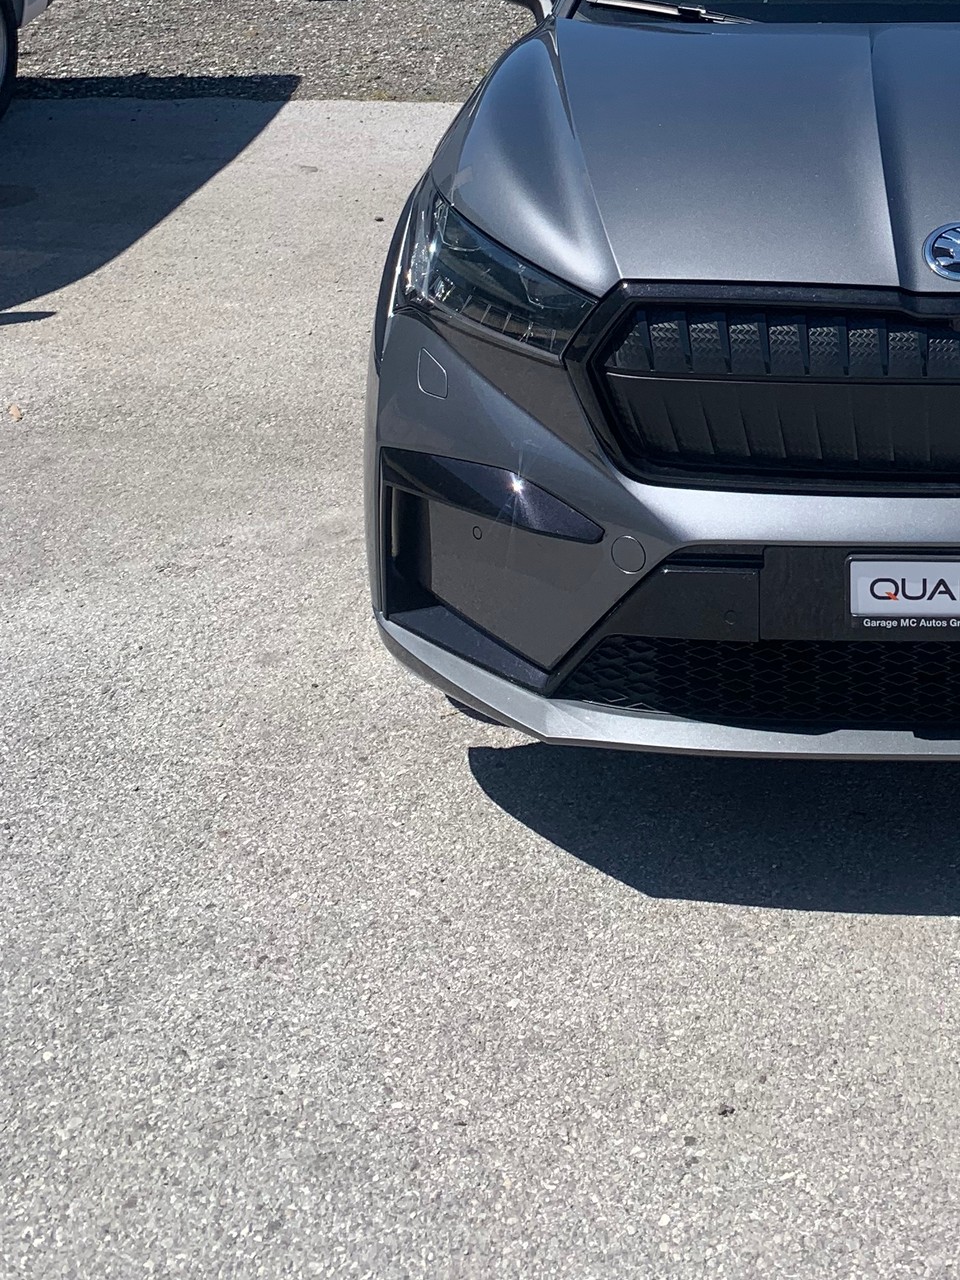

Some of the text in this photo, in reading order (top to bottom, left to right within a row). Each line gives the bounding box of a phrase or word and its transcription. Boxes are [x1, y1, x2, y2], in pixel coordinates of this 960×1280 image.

[863, 619, 898, 629] Garage
[900, 619, 917, 628] MC
[919, 619, 947, 628] Autos
